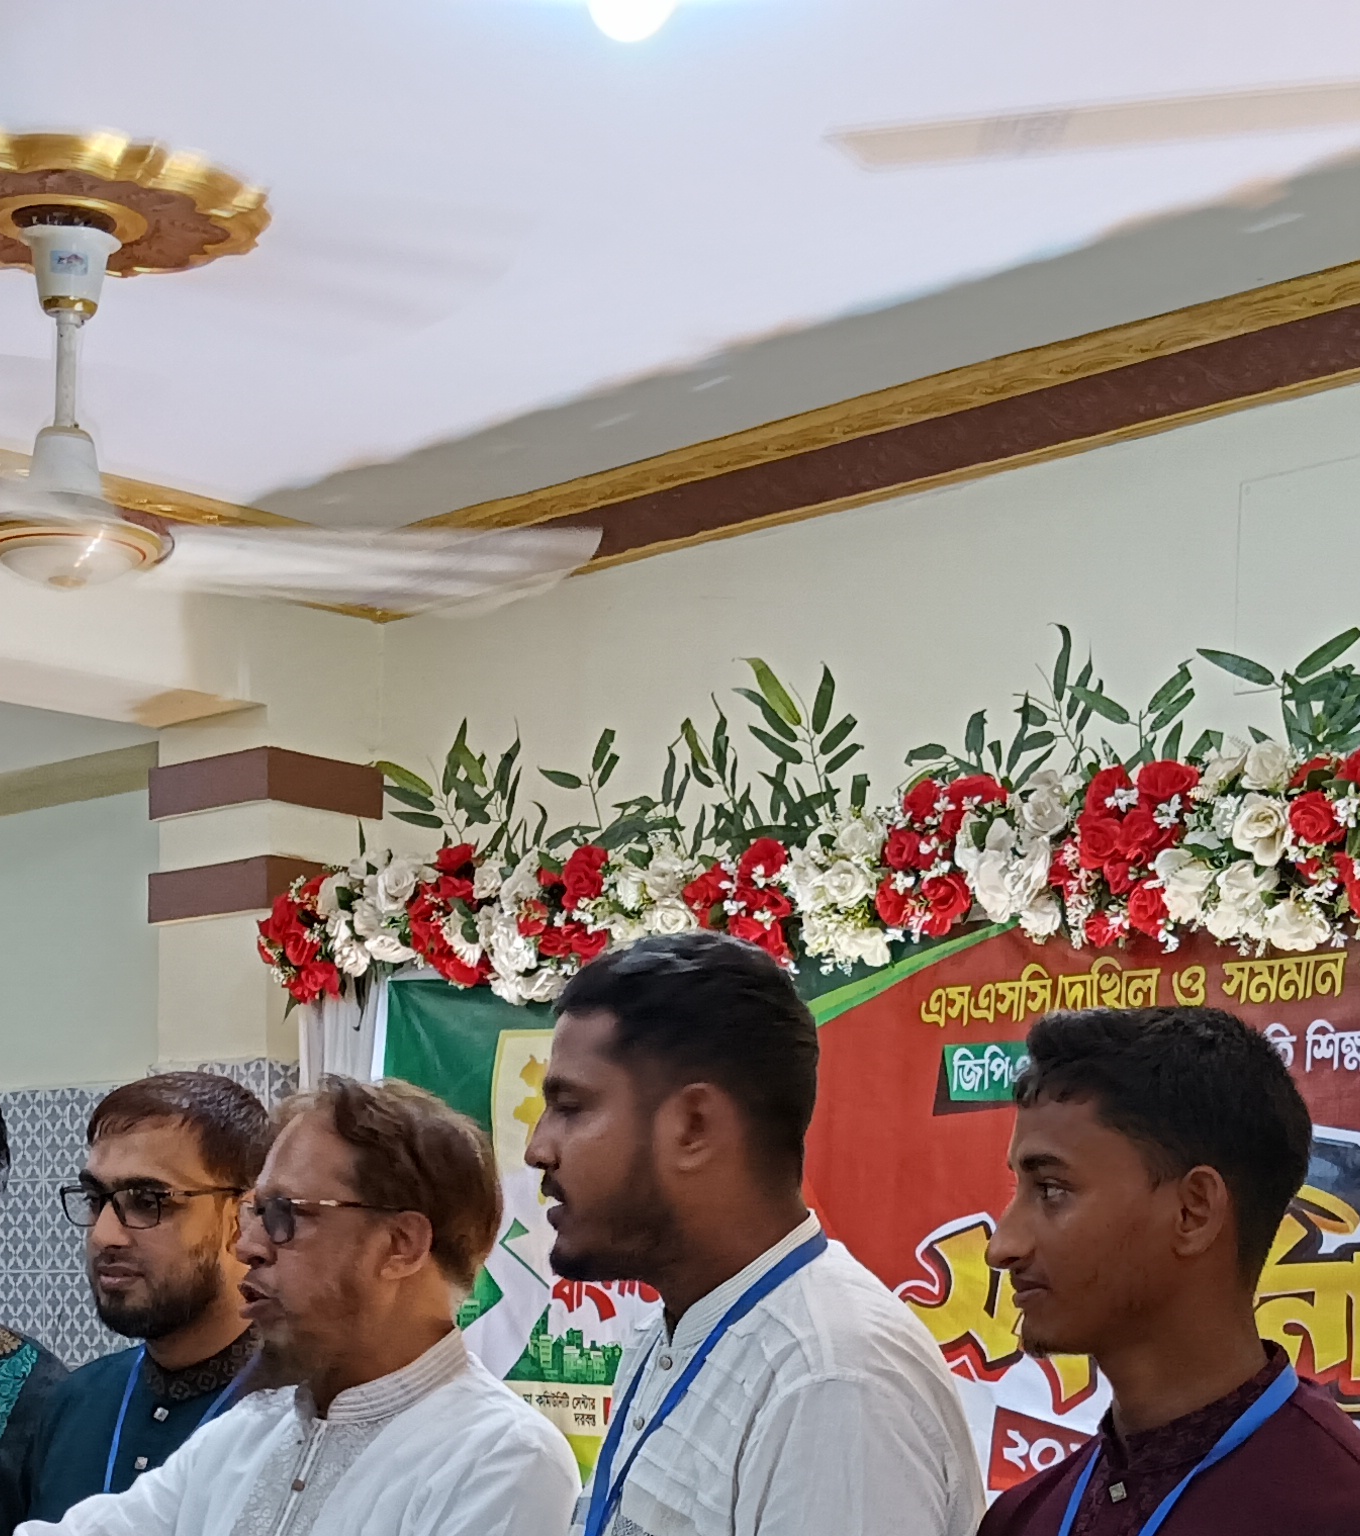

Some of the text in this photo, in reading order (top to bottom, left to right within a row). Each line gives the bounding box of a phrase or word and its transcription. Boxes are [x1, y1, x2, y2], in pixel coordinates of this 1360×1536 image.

[921, 957, 1161, 1027] এসএসসি/দাখিল
[1172, 965, 1206, 1008] ও
[1222, 951, 1348, 1004] সমমান
[572, 1392, 596, 1411] সেন্টার
